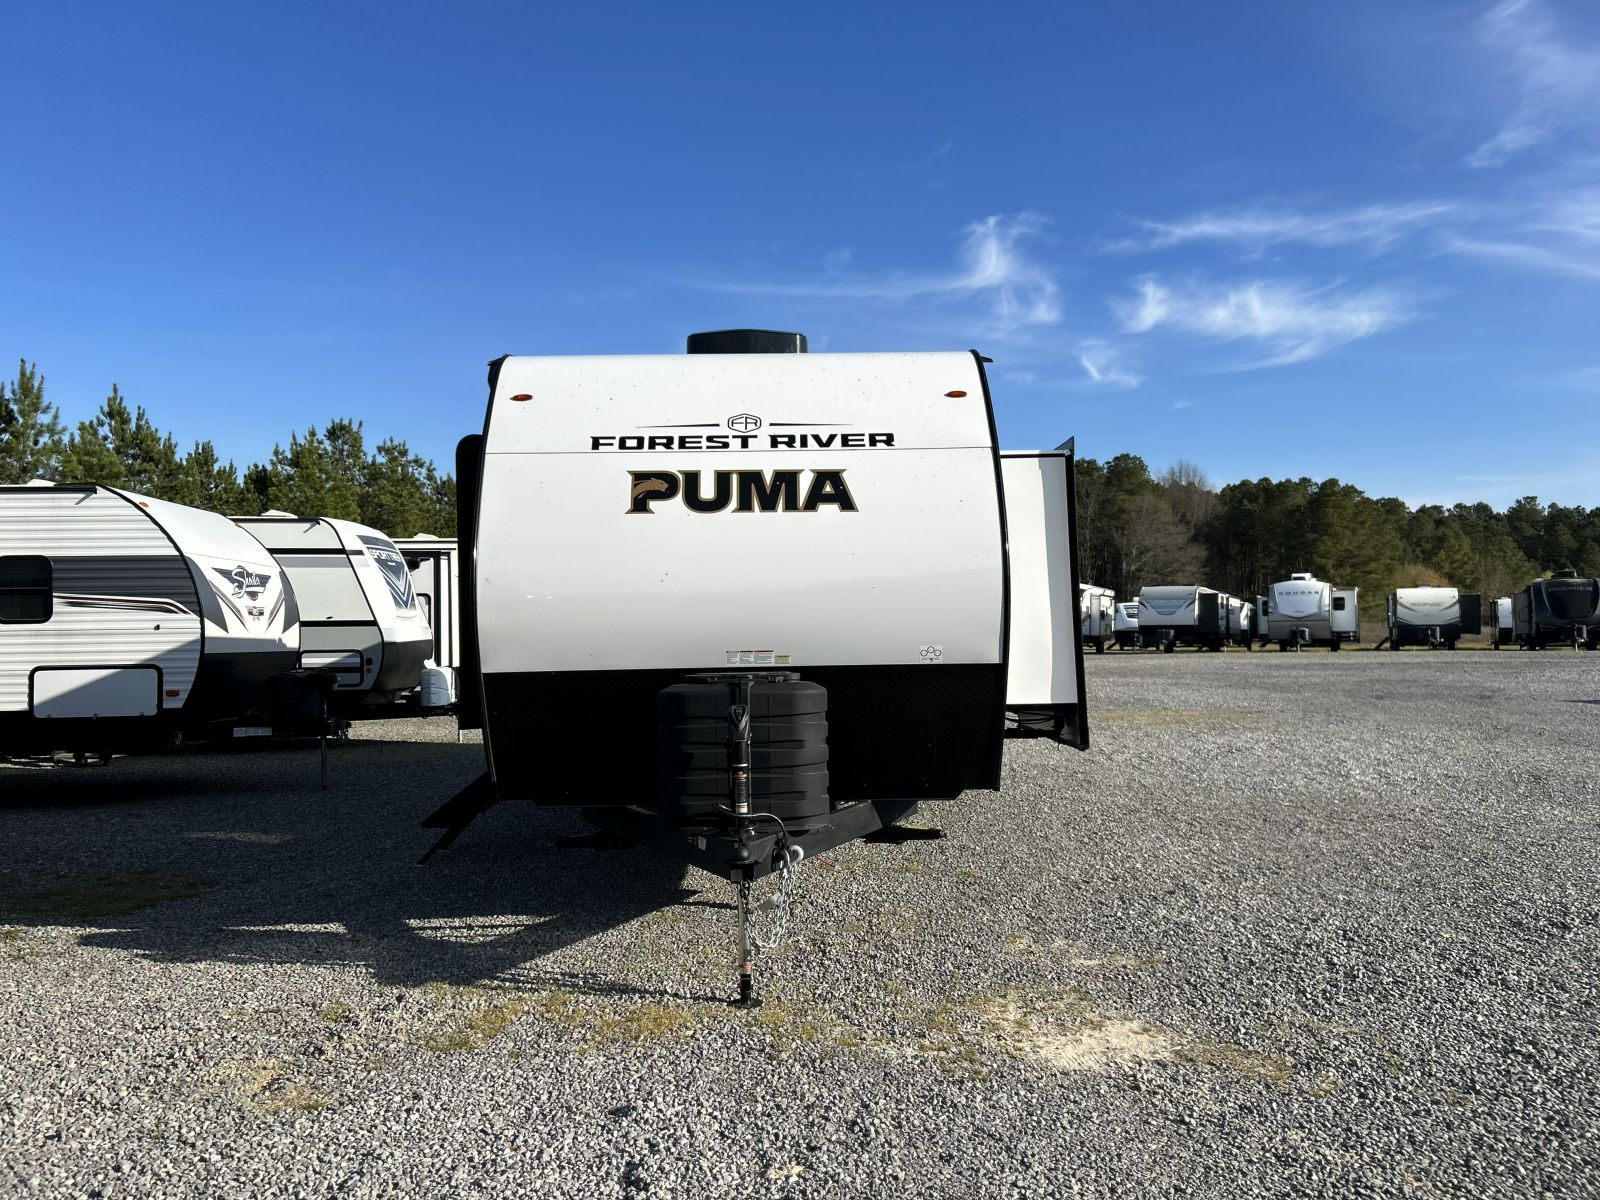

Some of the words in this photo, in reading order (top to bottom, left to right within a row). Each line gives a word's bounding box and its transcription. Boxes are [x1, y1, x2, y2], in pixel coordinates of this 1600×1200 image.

[590, 434, 758, 451] FOREST
[768, 432, 896, 449] RIVER
[624, 468, 859, 514] PUMA
